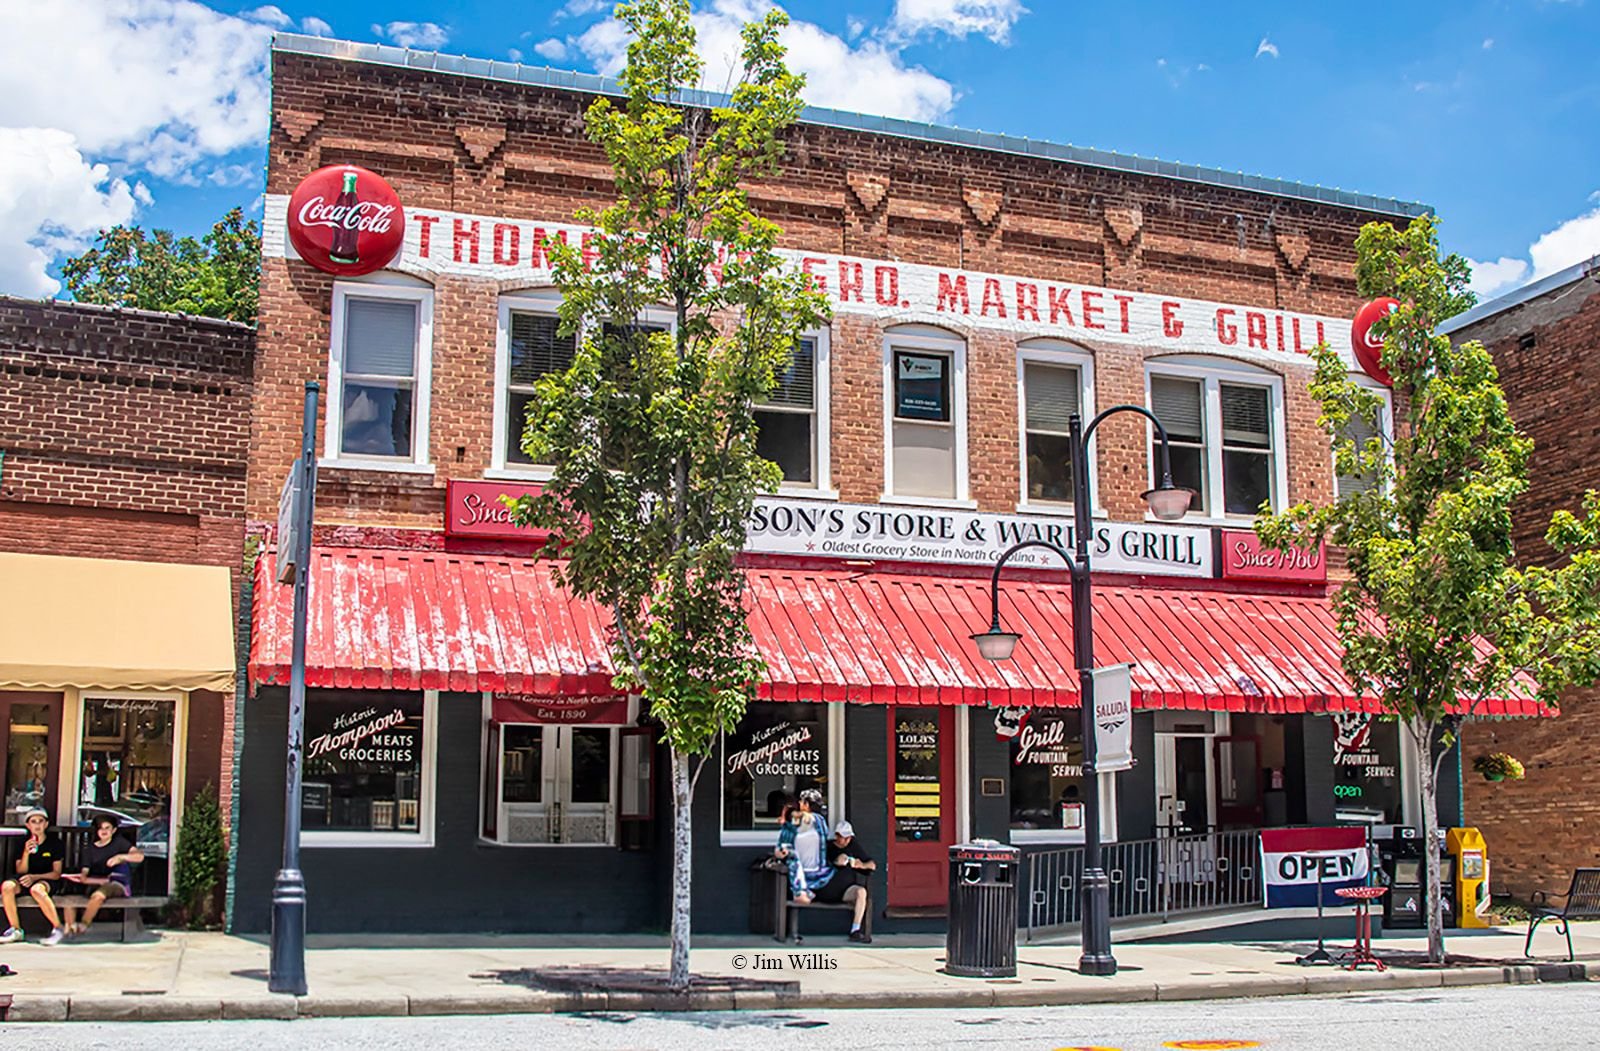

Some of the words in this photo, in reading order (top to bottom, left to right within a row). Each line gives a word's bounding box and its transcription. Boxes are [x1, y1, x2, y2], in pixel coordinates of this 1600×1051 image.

[802, 257, 910, 308] GRO.
[936, 272, 1134, 333] MARKET
[1161, 301, 1184, 339] &
[856, 511, 955, 540] STORE
[965, 518, 987, 543] &
[1121, 530, 1202, 566] GRILL
[822, 540, 860, 554] Oldest
[863, 542, 907, 559] Grocery
[909, 545, 939, 558] Store
[941, 548, 952, 559] in
[955, 549, 987, 562] North
[1232, 540, 1275, 569] Since
[333, 706, 377, 729] Historic
[1096, 701, 1129, 718] SALUDA
[307, 709, 406, 759] Thompson's
[372, 735, 414, 746] MEATS
[1016, 720, 1065, 763] Grill
[340, 748, 412, 761] GROCERIES
[728, 727, 812, 774] Thompson's
[783, 750, 820, 761] MEATS
[1027, 752, 1068, 764] FOUNTAIN
[1341, 754, 1379, 765] FOUNTAIN
[756, 764, 820, 775] GROCERIES
[1052, 764, 1083, 777] SERVIC
[1364, 766, 1395, 777] SERVICE
[1333, 785, 1362, 799] open
[1279, 853, 1357, 880] OPEN
